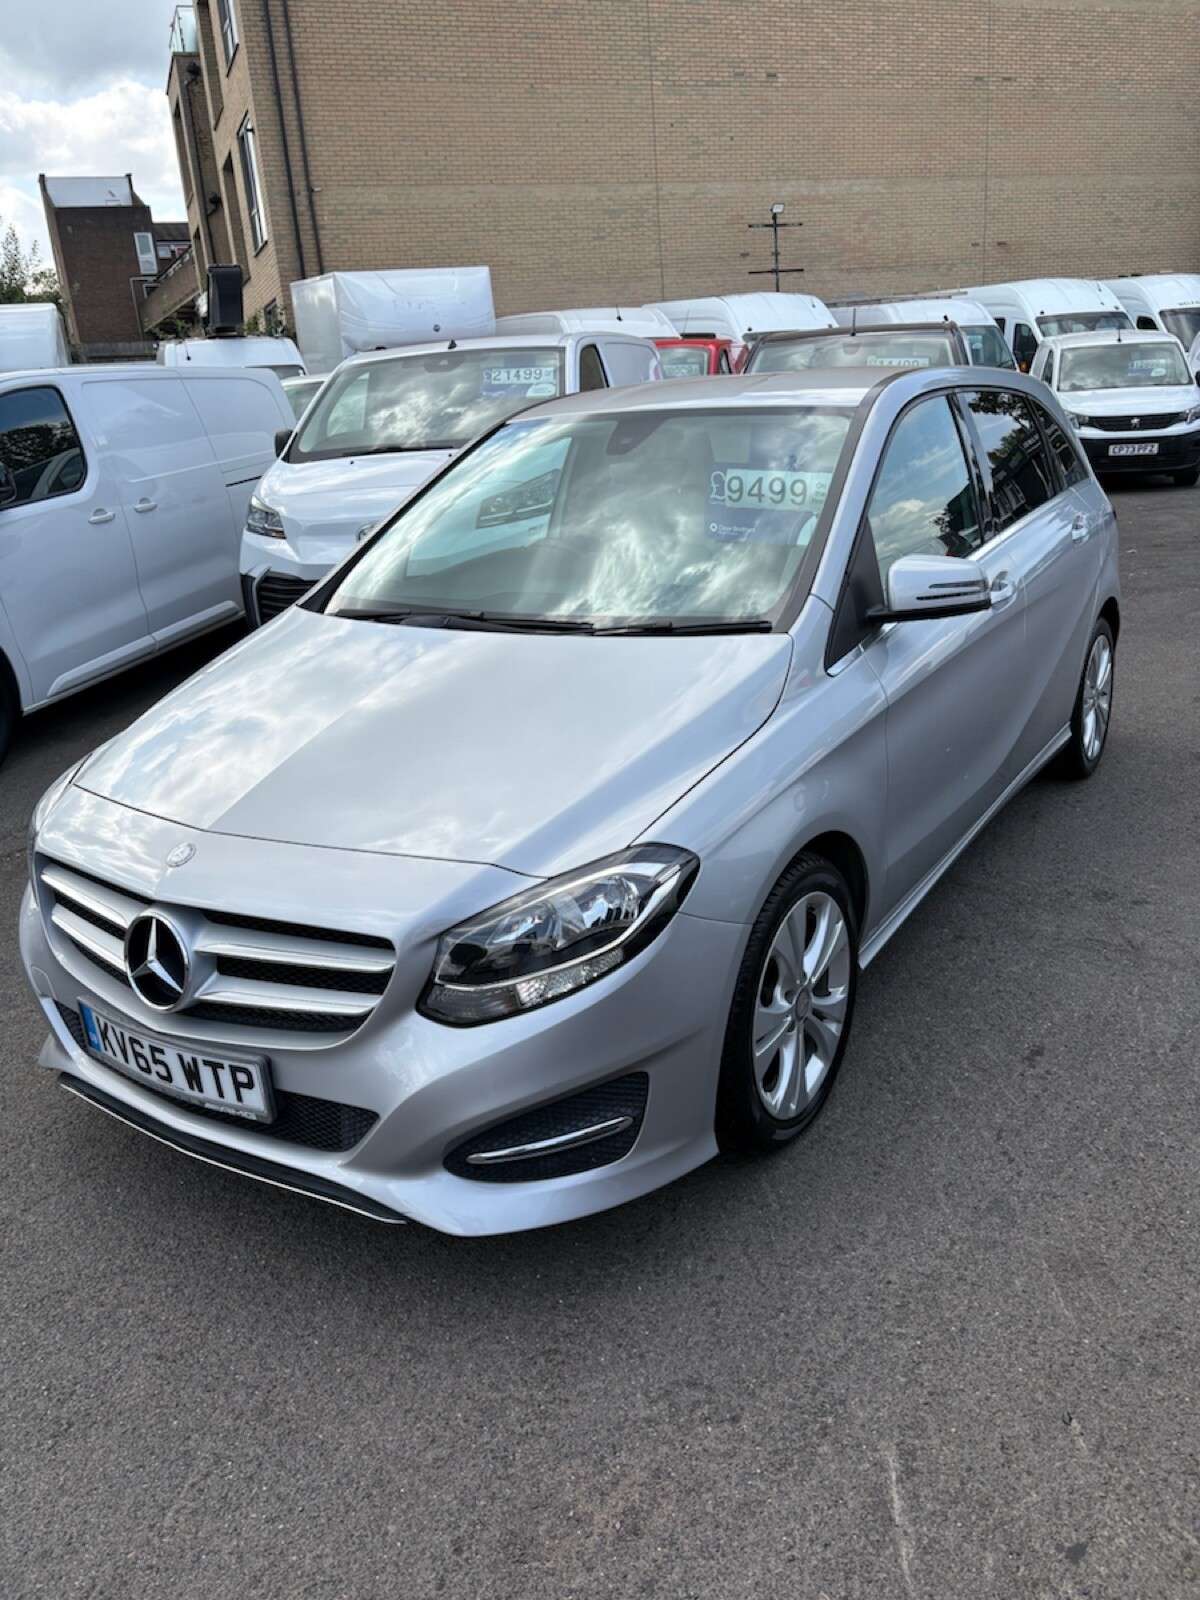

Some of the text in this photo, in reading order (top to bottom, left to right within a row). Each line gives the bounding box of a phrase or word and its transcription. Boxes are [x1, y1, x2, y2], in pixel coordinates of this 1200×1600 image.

[710, 471, 808, 505] £9499
[95, 1015, 255, 1104] KV65 WTP
